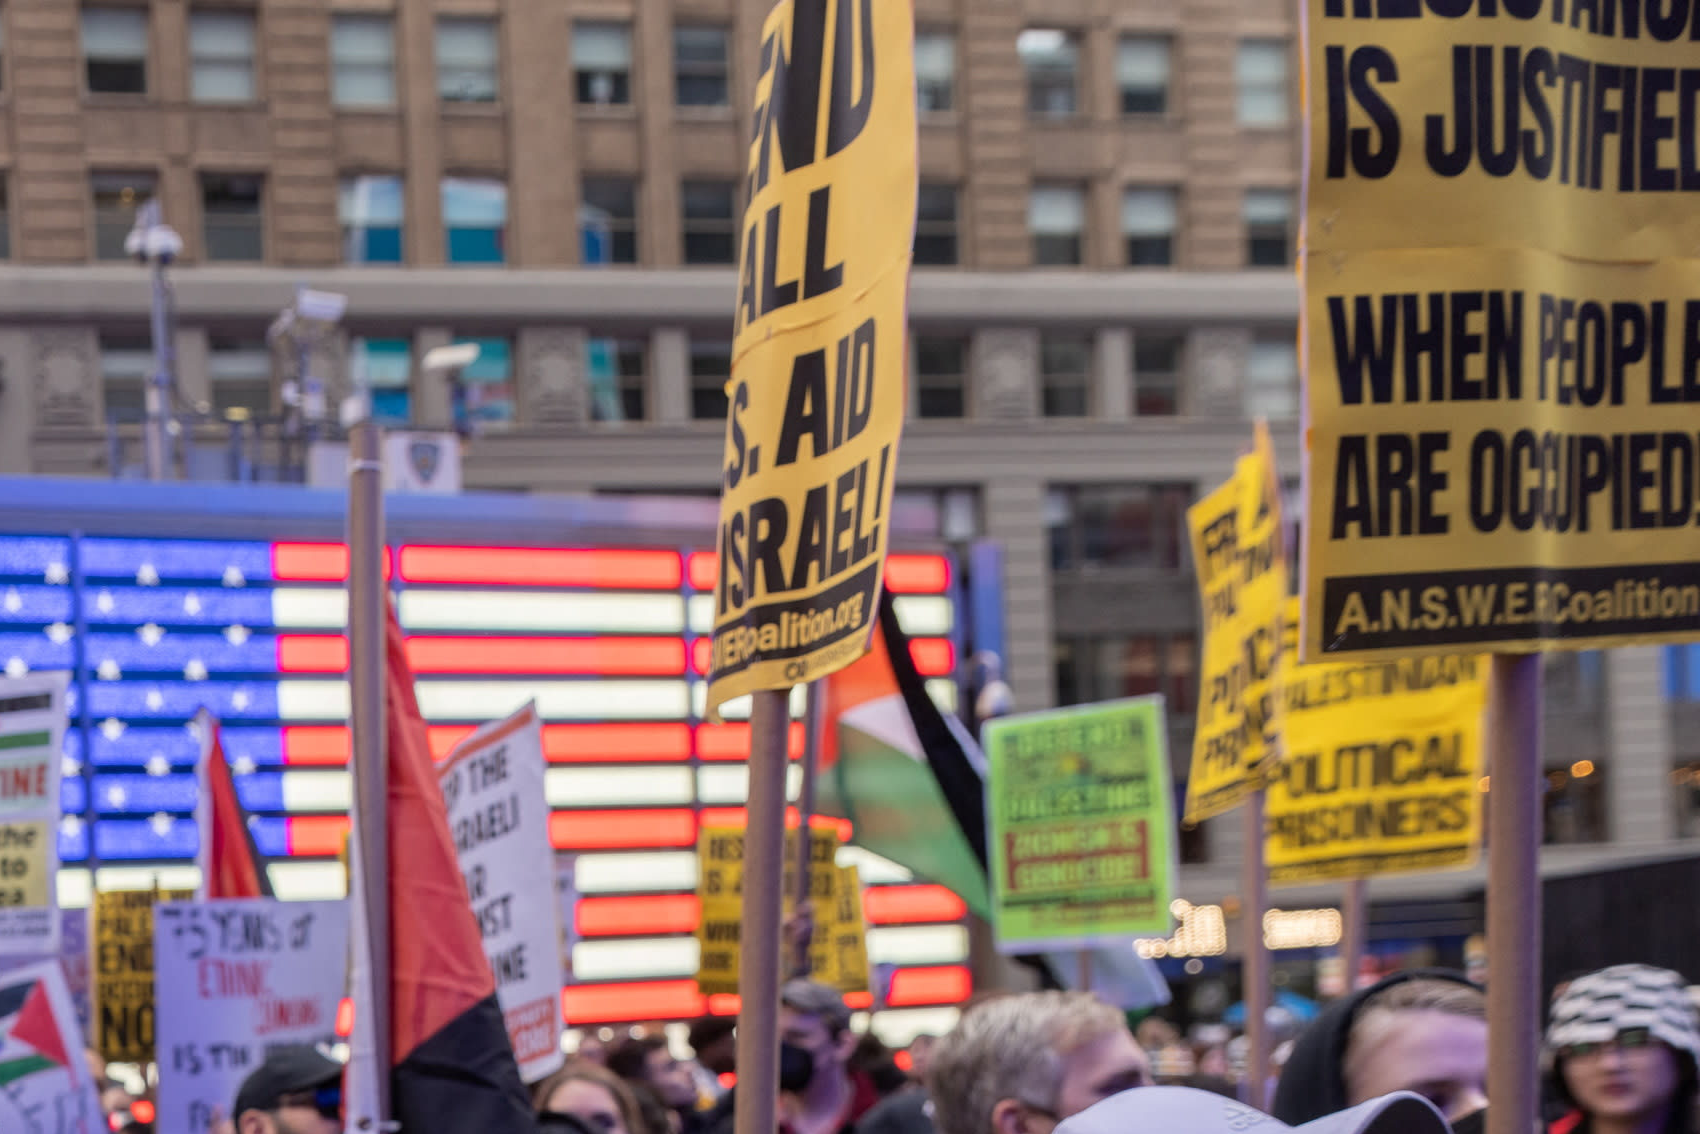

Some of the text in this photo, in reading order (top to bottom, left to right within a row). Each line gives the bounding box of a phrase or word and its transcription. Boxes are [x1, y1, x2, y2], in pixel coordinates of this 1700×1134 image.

[1325, 44, 1400, 180] IS
[734, 185, 843, 338] ALL
[775, 316, 876, 467] AID
[1327, 291, 1524, 406] WHEN
[719, 444, 891, 615] ISRAEL!
[1330, 430, 1451, 541] ARE
[1, 855, 29, 880] to
[455, 795, 520, 850] RAELI
